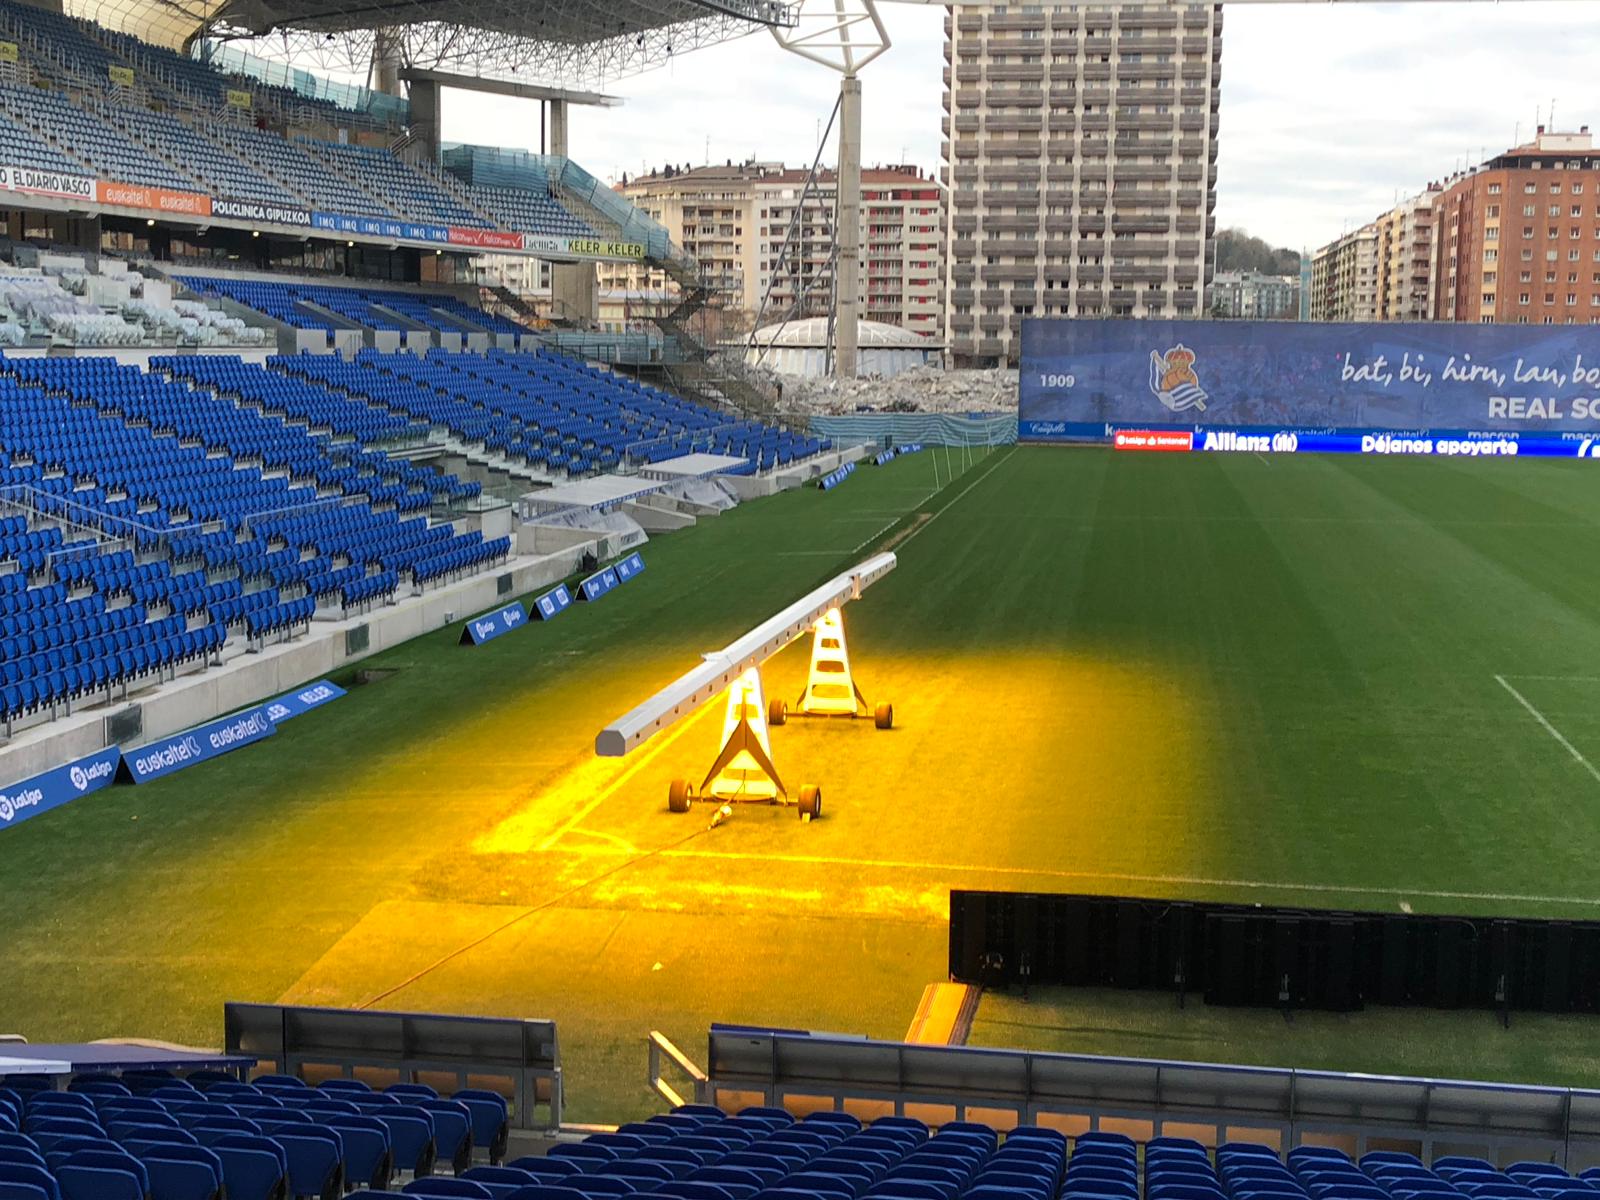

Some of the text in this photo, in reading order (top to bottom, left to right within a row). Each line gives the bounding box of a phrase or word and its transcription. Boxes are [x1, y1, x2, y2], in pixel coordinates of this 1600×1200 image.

[13, 170, 25, 186] EL
[26, 172, 59, 191] DIARIO
[60, 178, 91, 195] VASCO
[212, 200, 311, 224] POLICLINICA GIPUZKOA
[319, 216, 335, 230] IMQ
[341, 219, 357, 232] IMQ
[365, 222, 380, 235] IMQ
[386, 224, 402, 237] IMQ
[410, 226, 426, 239] IMQ
[432, 228, 448, 241] IMQ
[568, 239, 600, 253] KELER
[607, 243, 641, 256] KELER
[1341, 352, 1393, 387] bat,
[1400, 352, 1431, 387] bi,
[1040, 374, 1075, 388] 1909
[1488, 397, 1563, 419] REAL
[1203, 432, 1271, 451] Allianz
[1361, 435, 1518, 456] Déjanos apoyarte
[298, 685, 334, 704] KELER
[209, 715, 260, 748] euskaltel
[136, 738, 190, 775] euskaltel
[84, 761, 113, 780] LaLiga
[11, 788, 43, 810] LaLiga
